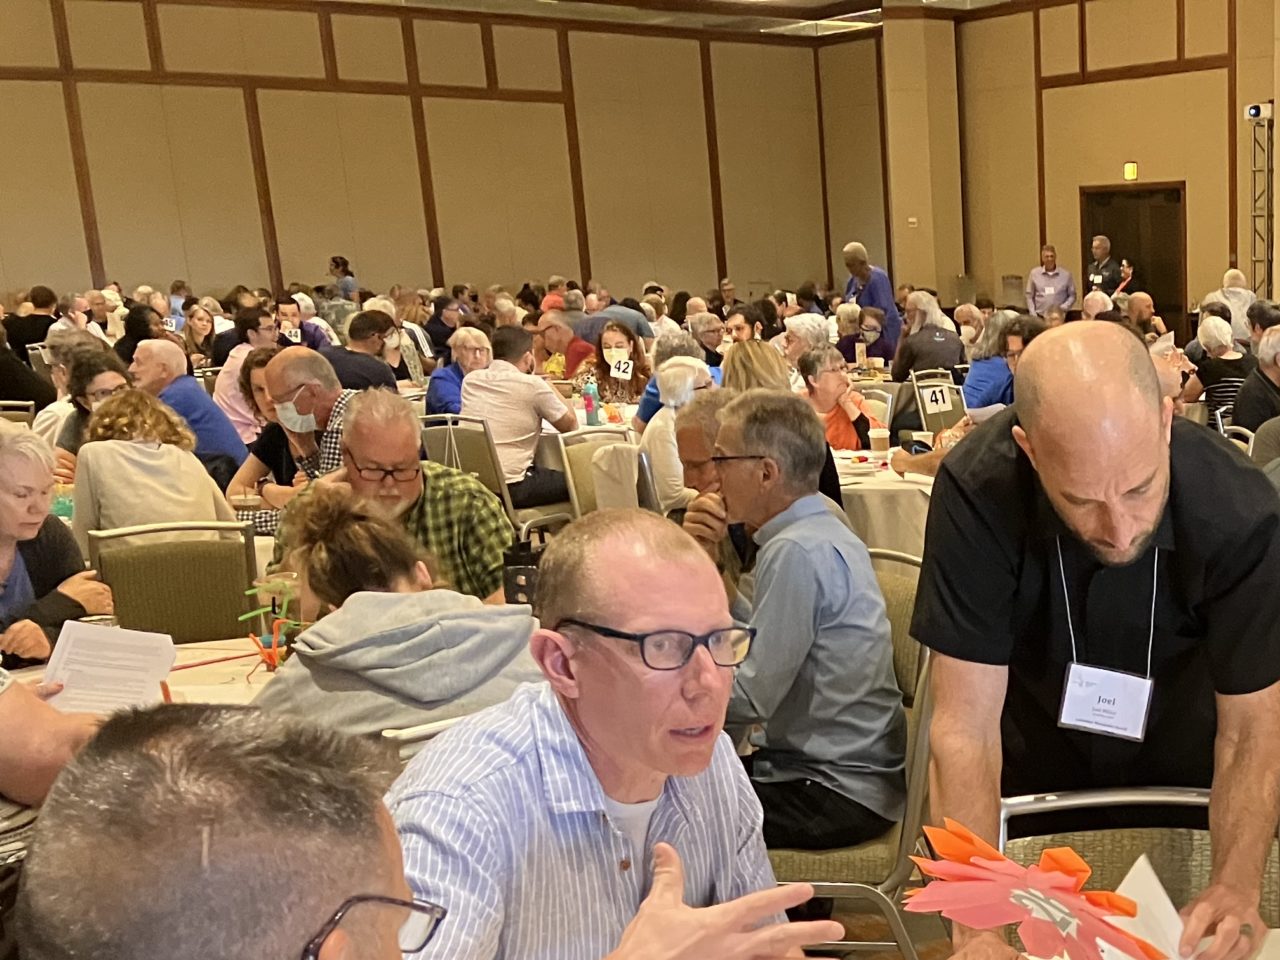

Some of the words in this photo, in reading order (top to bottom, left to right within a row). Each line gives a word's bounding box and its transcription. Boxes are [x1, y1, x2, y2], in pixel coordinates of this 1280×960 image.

[287, 330, 299, 339] 44
[614, 360, 630, 374] 42
[930, 388, 946, 405] 41
[1097, 695, 1116, 706] Joel
